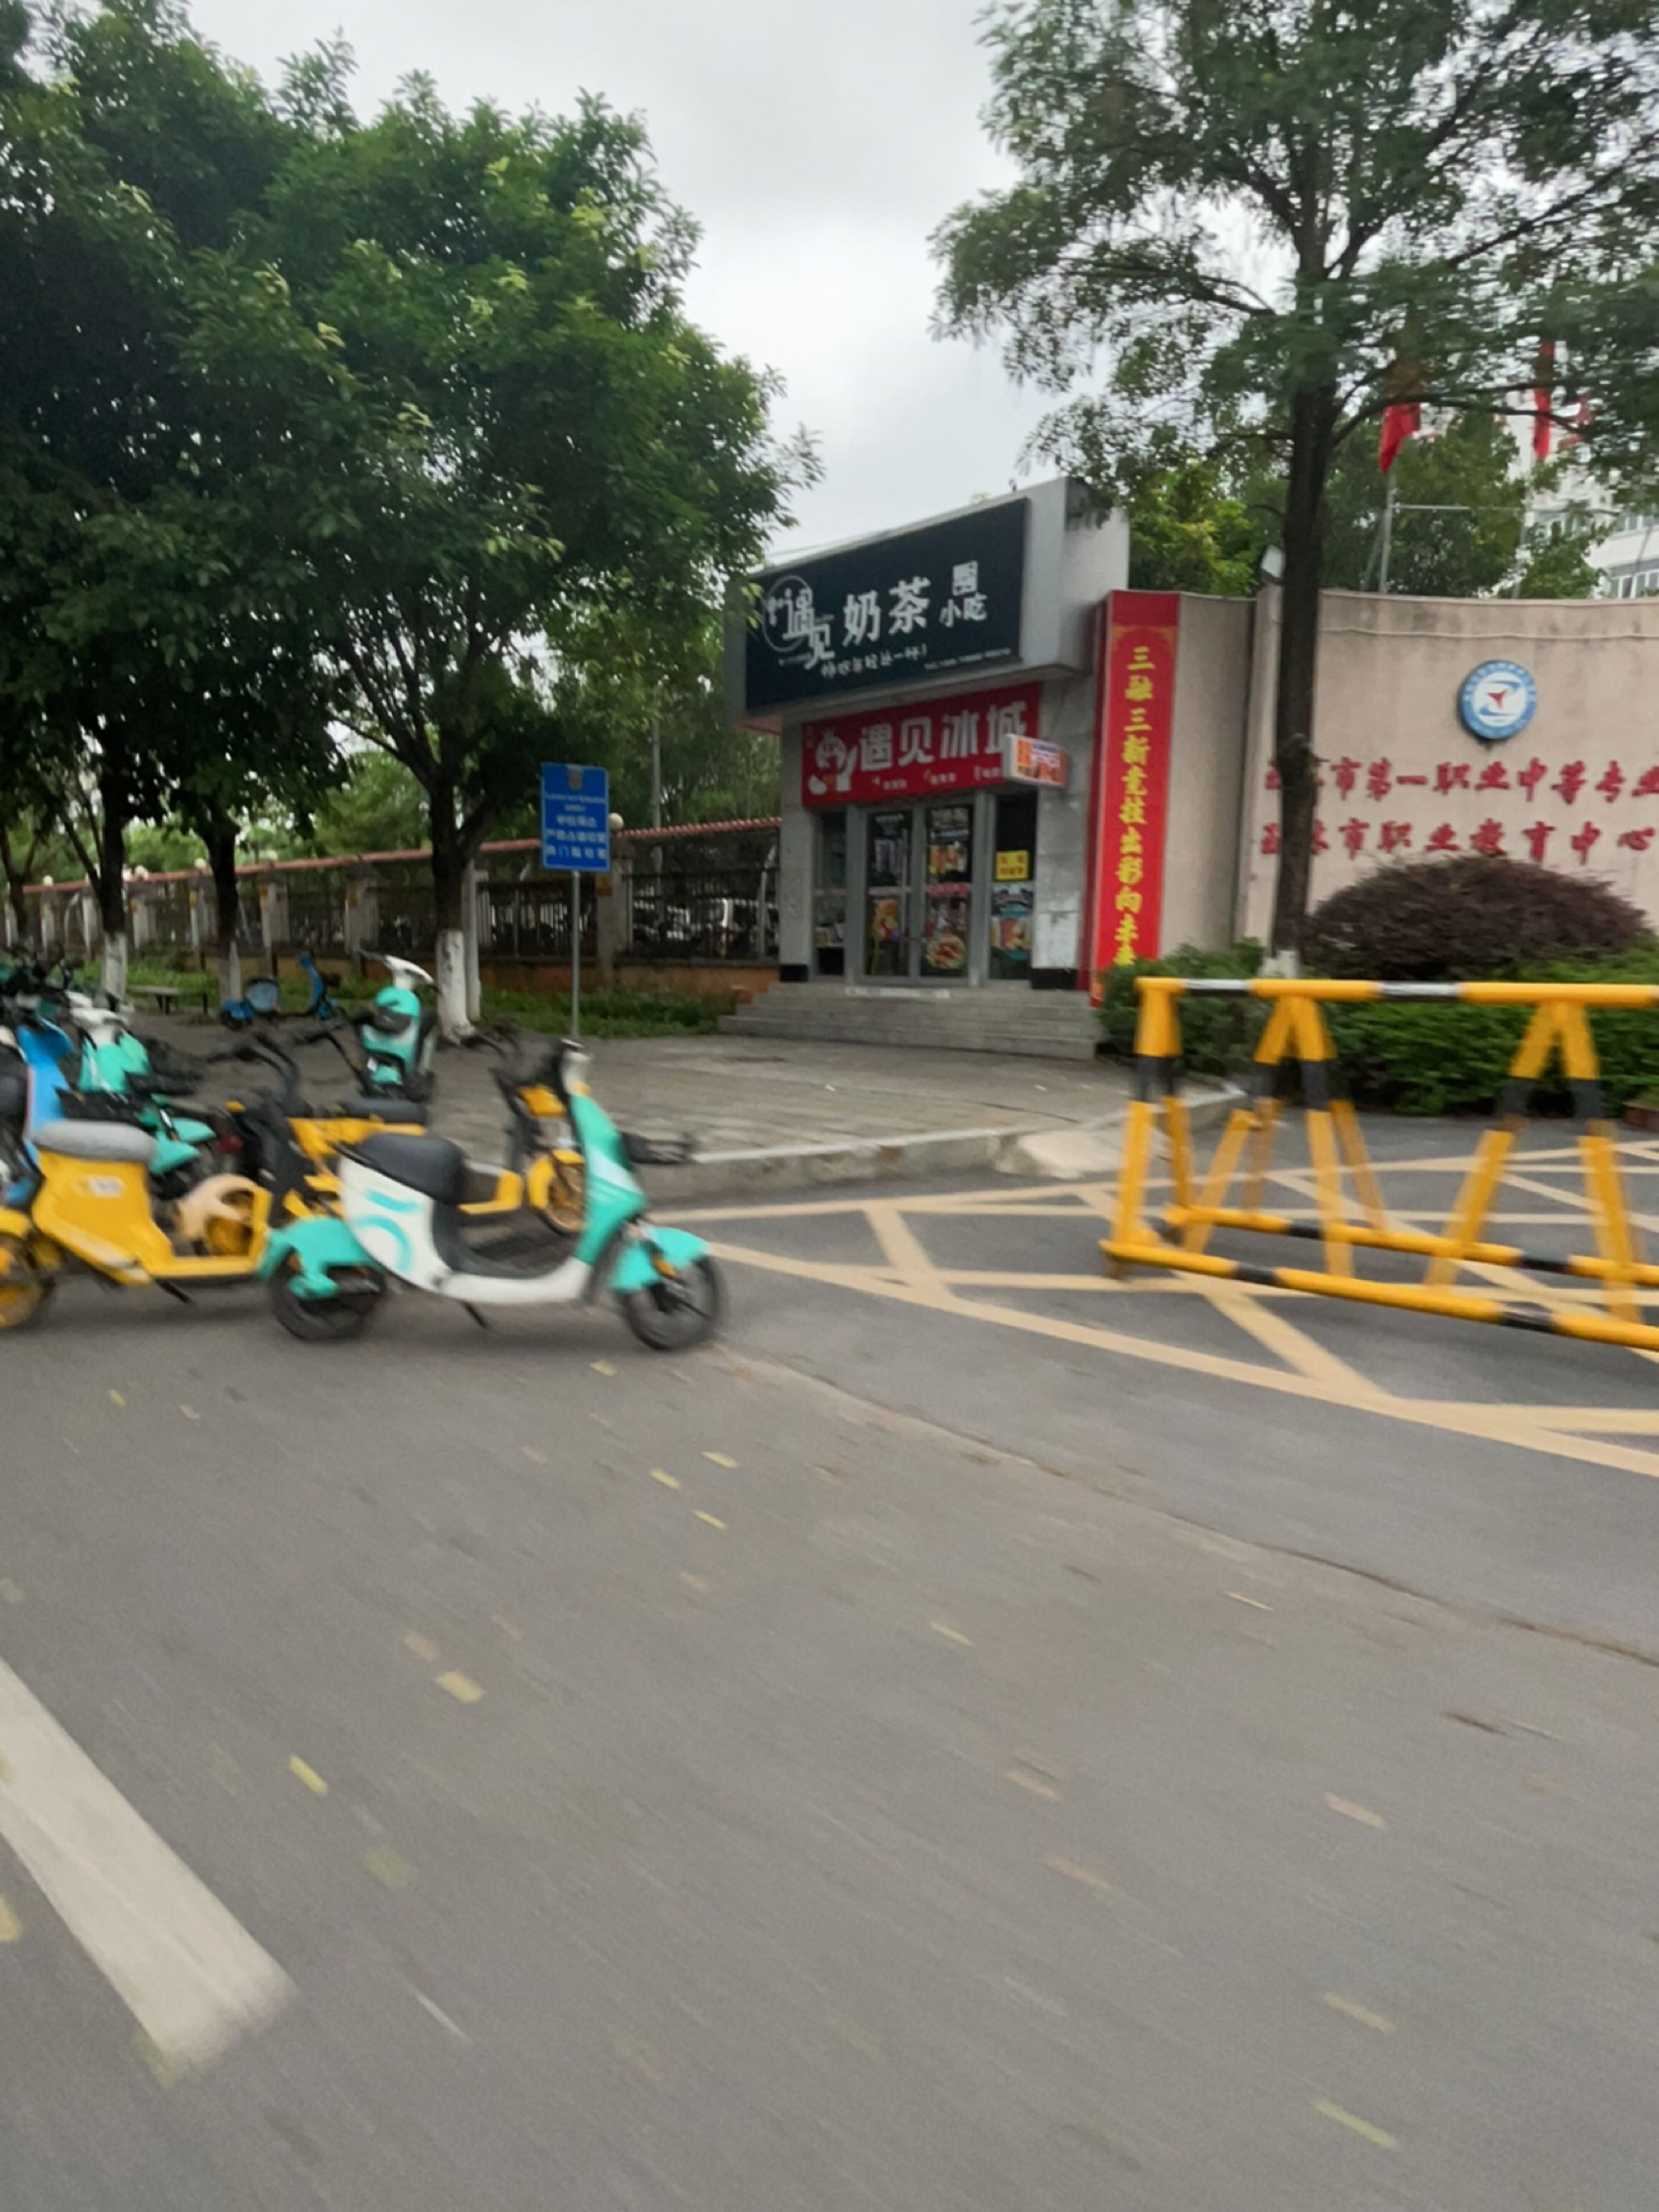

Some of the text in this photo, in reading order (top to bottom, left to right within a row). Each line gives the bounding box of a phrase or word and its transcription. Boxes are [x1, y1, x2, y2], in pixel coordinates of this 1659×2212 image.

[842, 576, 932, 647] 奶茶
[938, 592, 988, 627] 小吃
[860, 701, 1027, 772] 遇见冰城
[1265, 757, 1659, 805] 市第一职业中等专业
